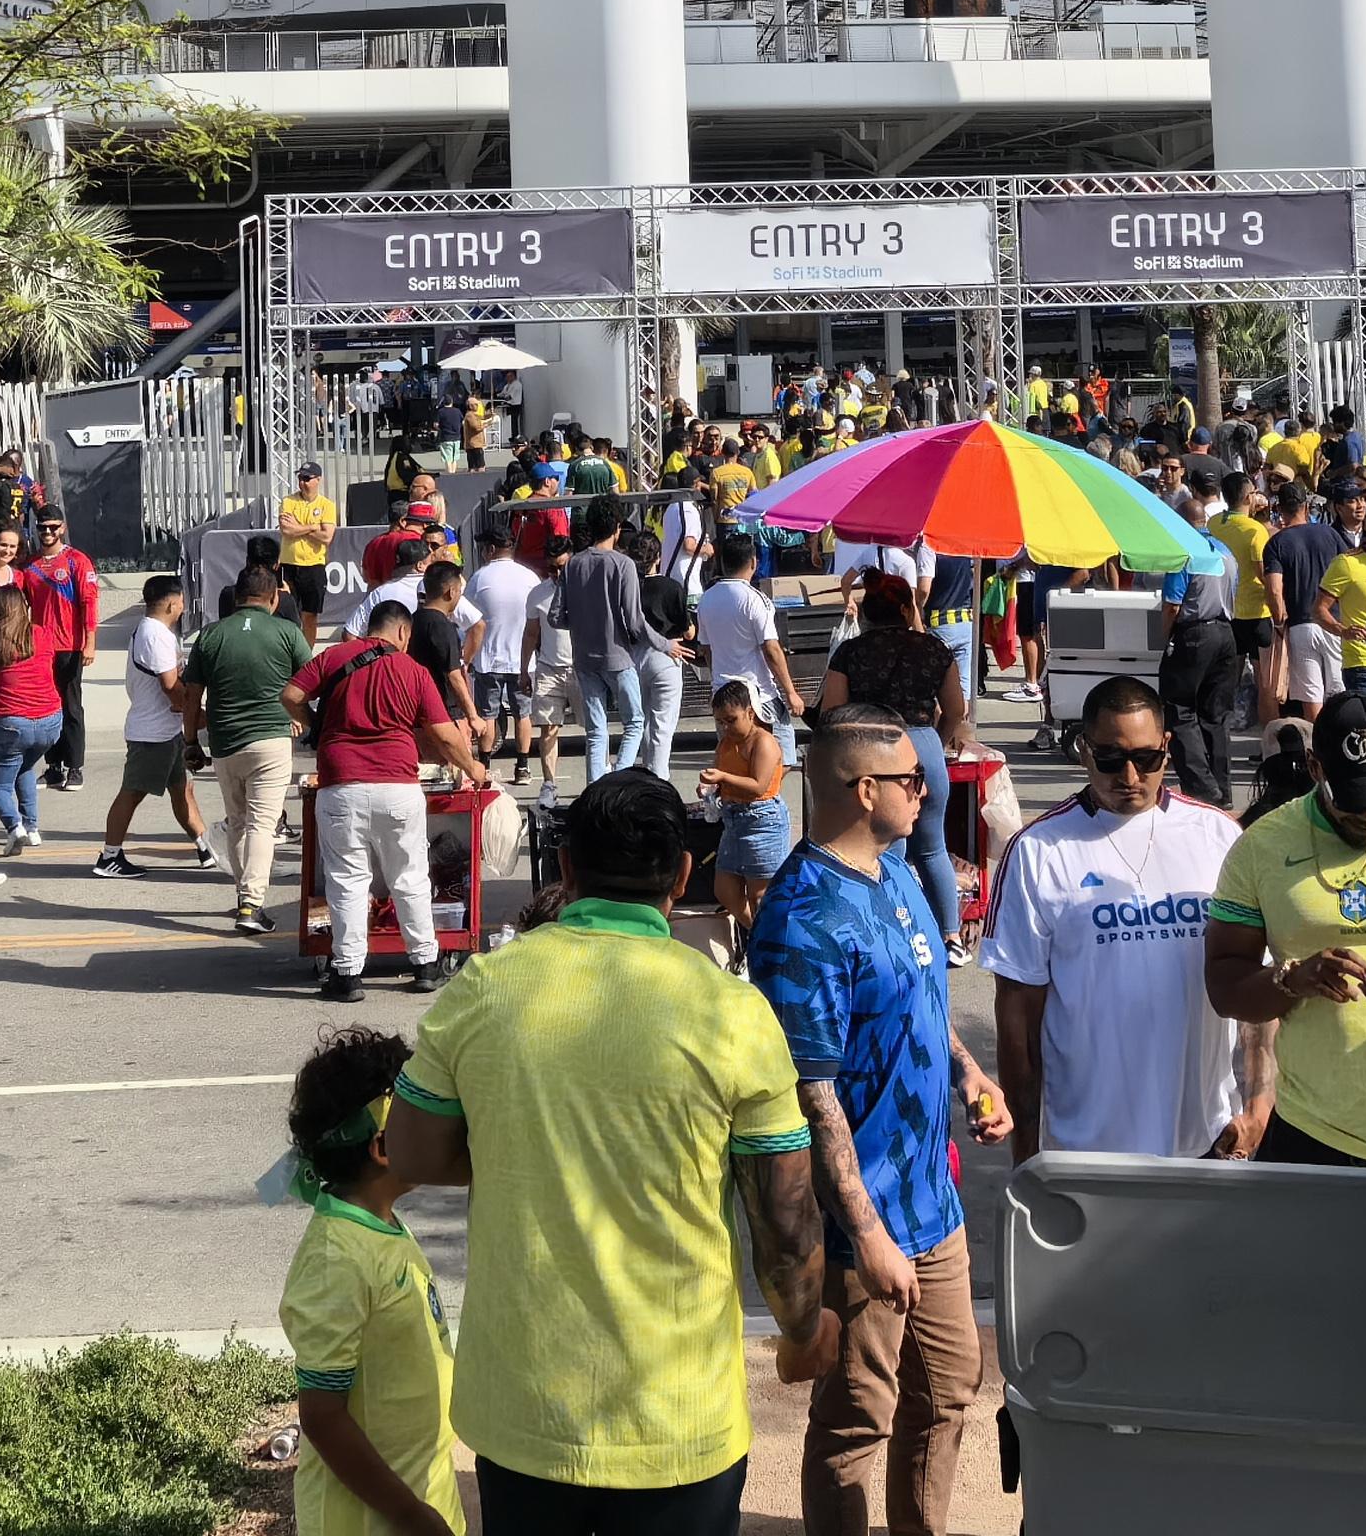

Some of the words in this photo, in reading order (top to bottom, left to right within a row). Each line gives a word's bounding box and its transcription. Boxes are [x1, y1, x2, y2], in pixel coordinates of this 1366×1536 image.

[1111, 211, 1227, 248] ENTRY
[1241, 210, 1265, 246] 3
[750, 221, 866, 258] ENTRY
[882, 220, 904, 256] 3
[384, 231, 503, 269] ENTRY
[520, 229, 543, 265] 3
[1133, 256, 1165, 271] SoFi
[1183, 254, 1244, 270] Stadium
[773, 266, 804, 281] SoFi
[822, 264, 883, 280] Stadium
[408, 276, 440, 292] SoFi
[458, 274, 520, 291] Stadium
[82, 431, 91, 444] 3
[104, 429, 132, 439] ENTRY
[1091, 892, 1213, 930] adidas
[1096, 928, 1208, 945] SPORTSWE
